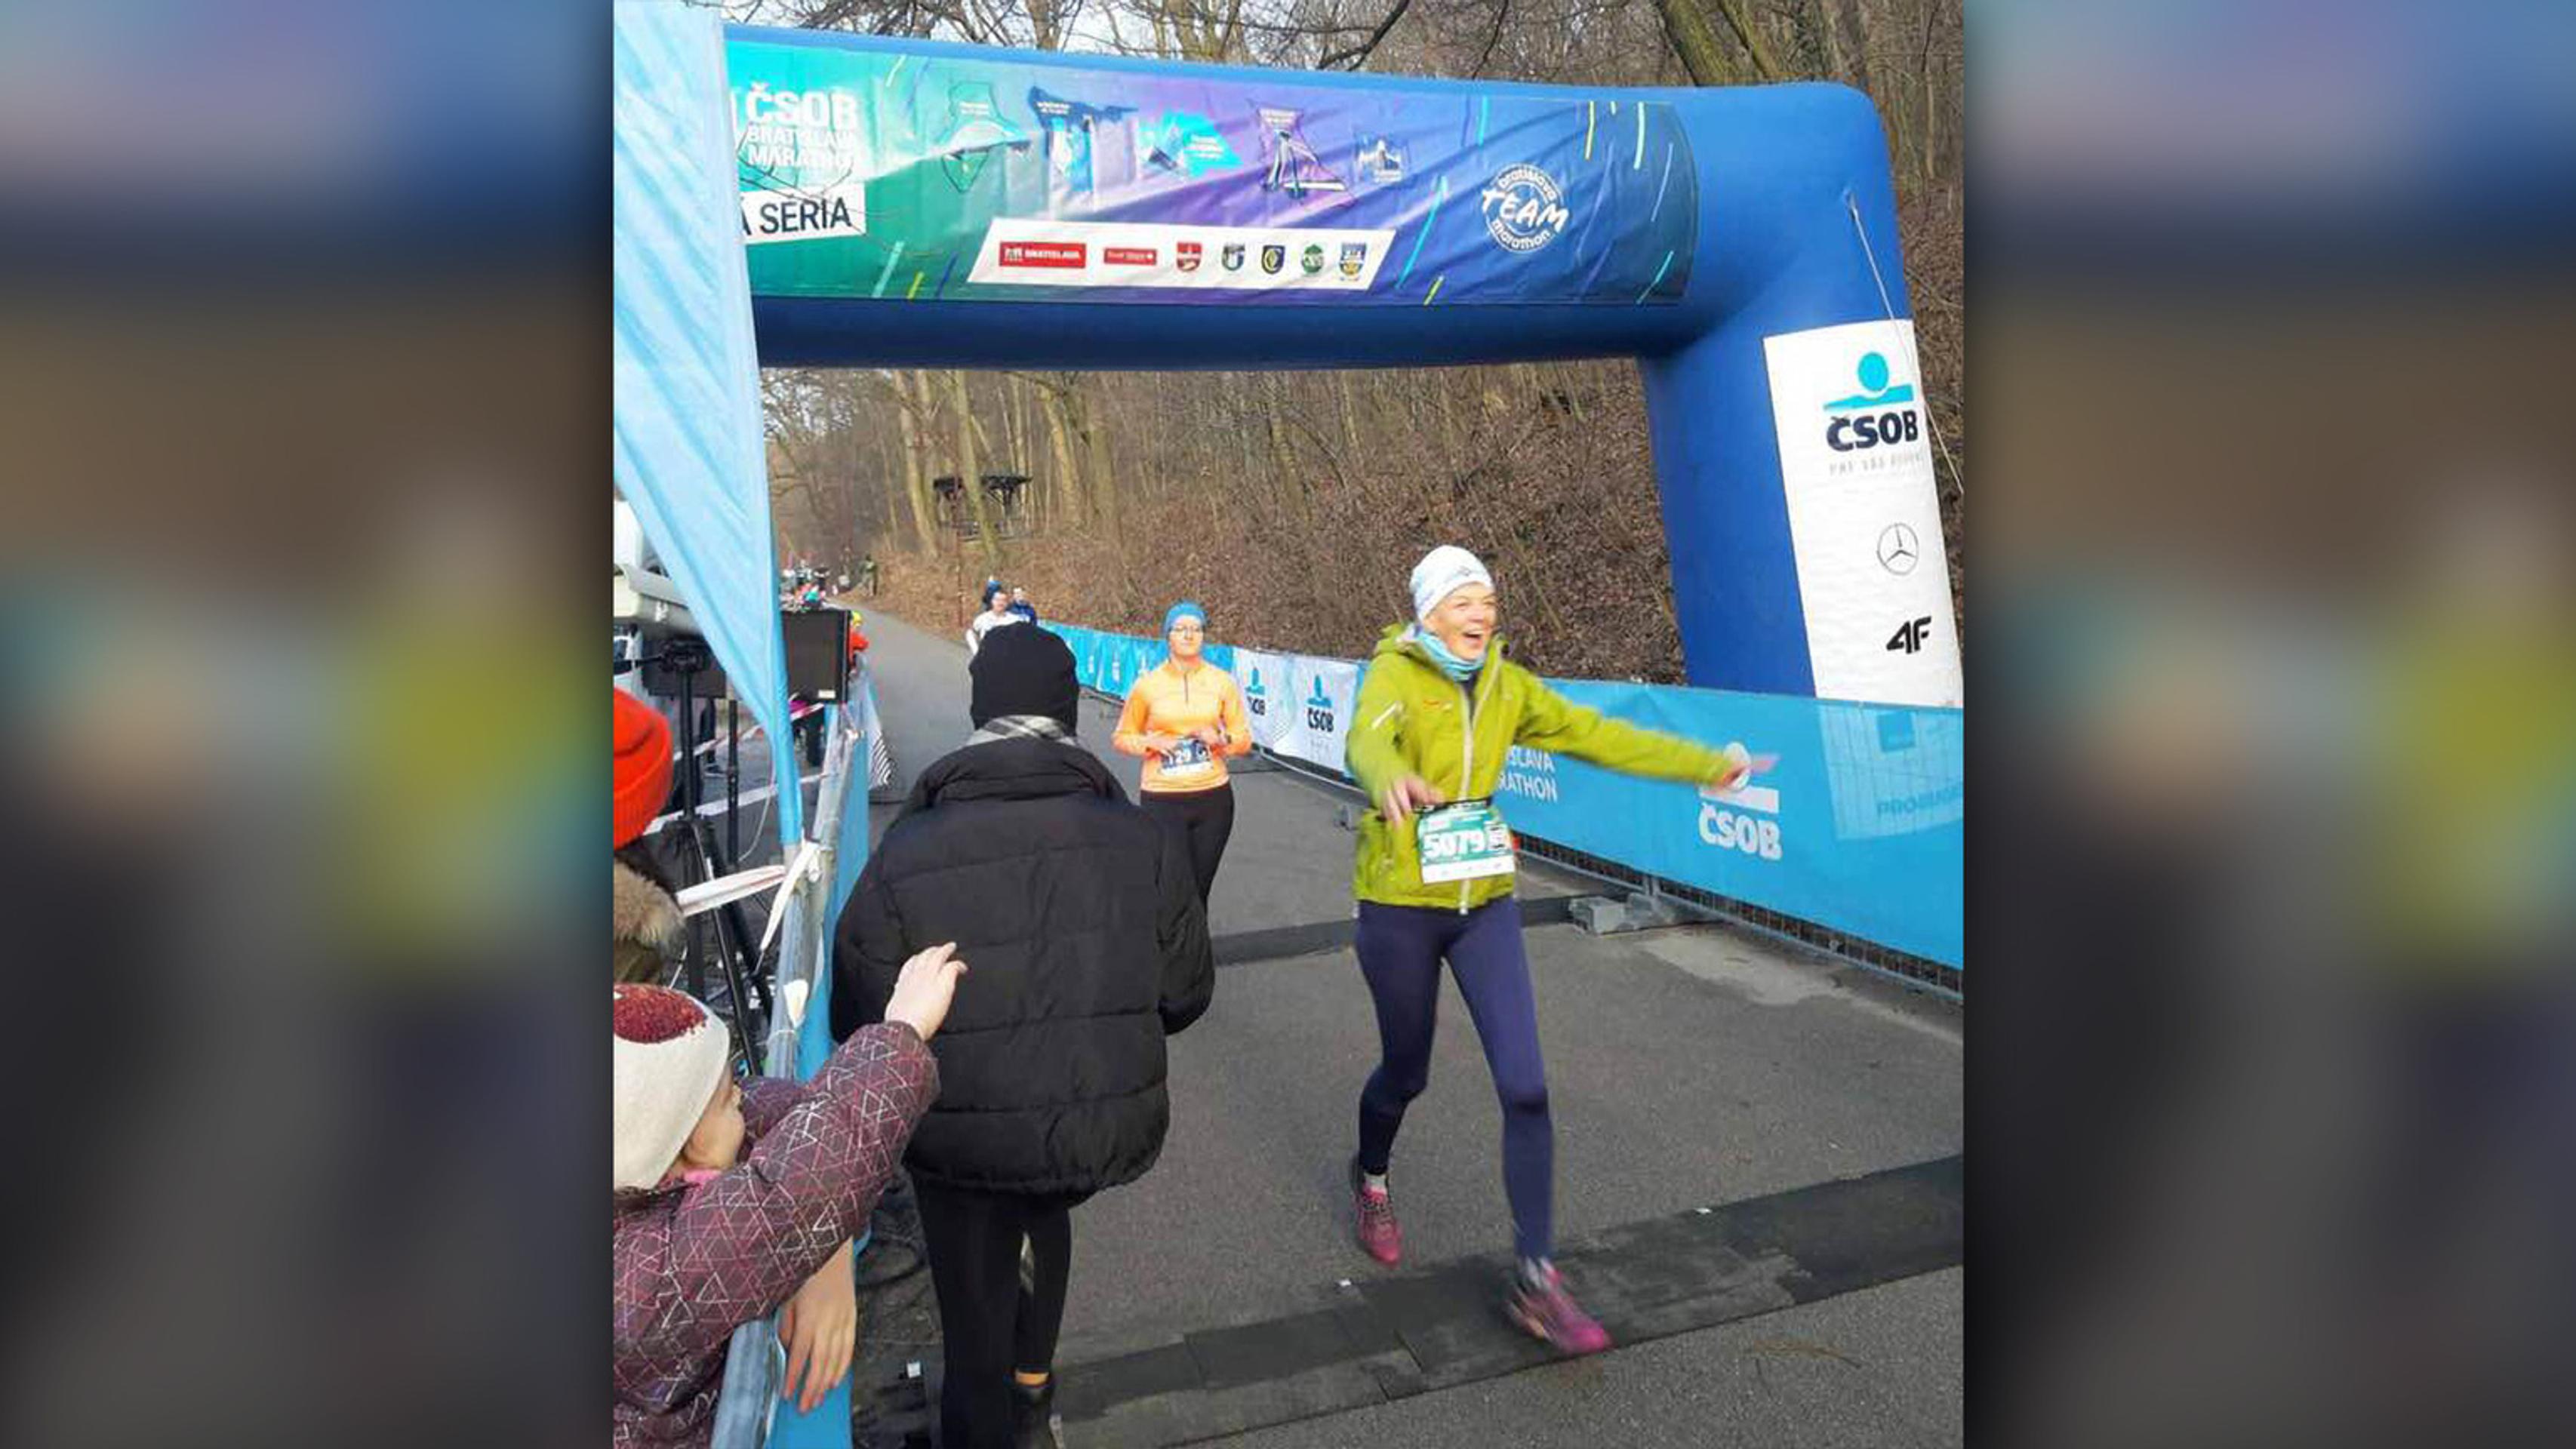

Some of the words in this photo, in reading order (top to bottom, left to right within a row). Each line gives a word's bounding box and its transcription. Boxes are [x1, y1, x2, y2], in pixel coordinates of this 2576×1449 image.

[746, 82, 857, 130] ČSOB
[1482, 188, 1569, 233] TEAM
[1827, 409, 1919, 452] ČSOB
[1886, 615, 1932, 654] 4F
[1497, 771, 1558, 803] RATHON
[1423, 829, 1485, 858] 5079
[1698, 801, 1783, 860] ČSOB
